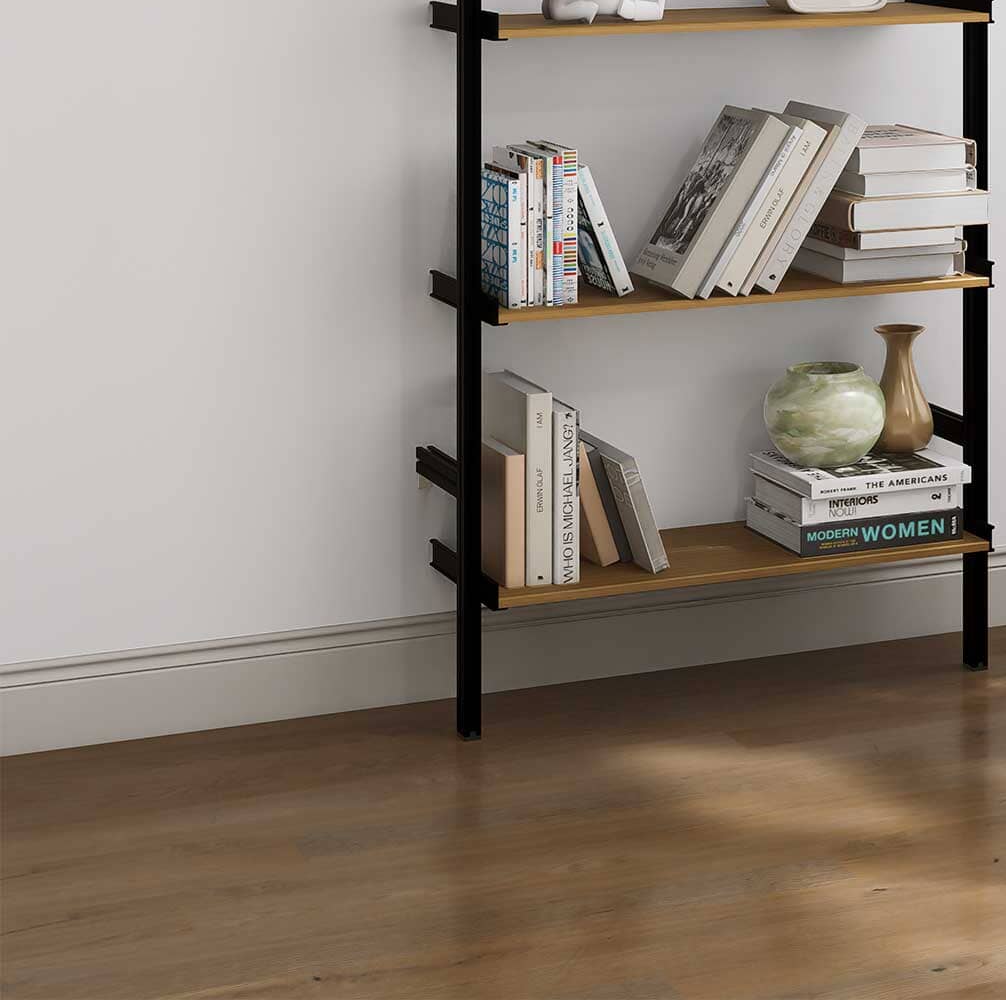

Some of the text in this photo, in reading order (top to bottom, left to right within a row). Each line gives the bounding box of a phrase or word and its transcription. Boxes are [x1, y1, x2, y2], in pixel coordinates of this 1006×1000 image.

[759, 206, 776, 230] ERWIN
[536, 467, 544, 488] OLAF
[865, 480, 885, 489] THE
[887, 473, 949, 488] AMERICANS
[536, 488, 544, 513] ERWIN
[563, 423, 574, 584] WHO IS MICHAEL JANG?
[828, 495, 879, 509] INTERIORS
[806, 518, 945, 543] MODERN WOMEN
